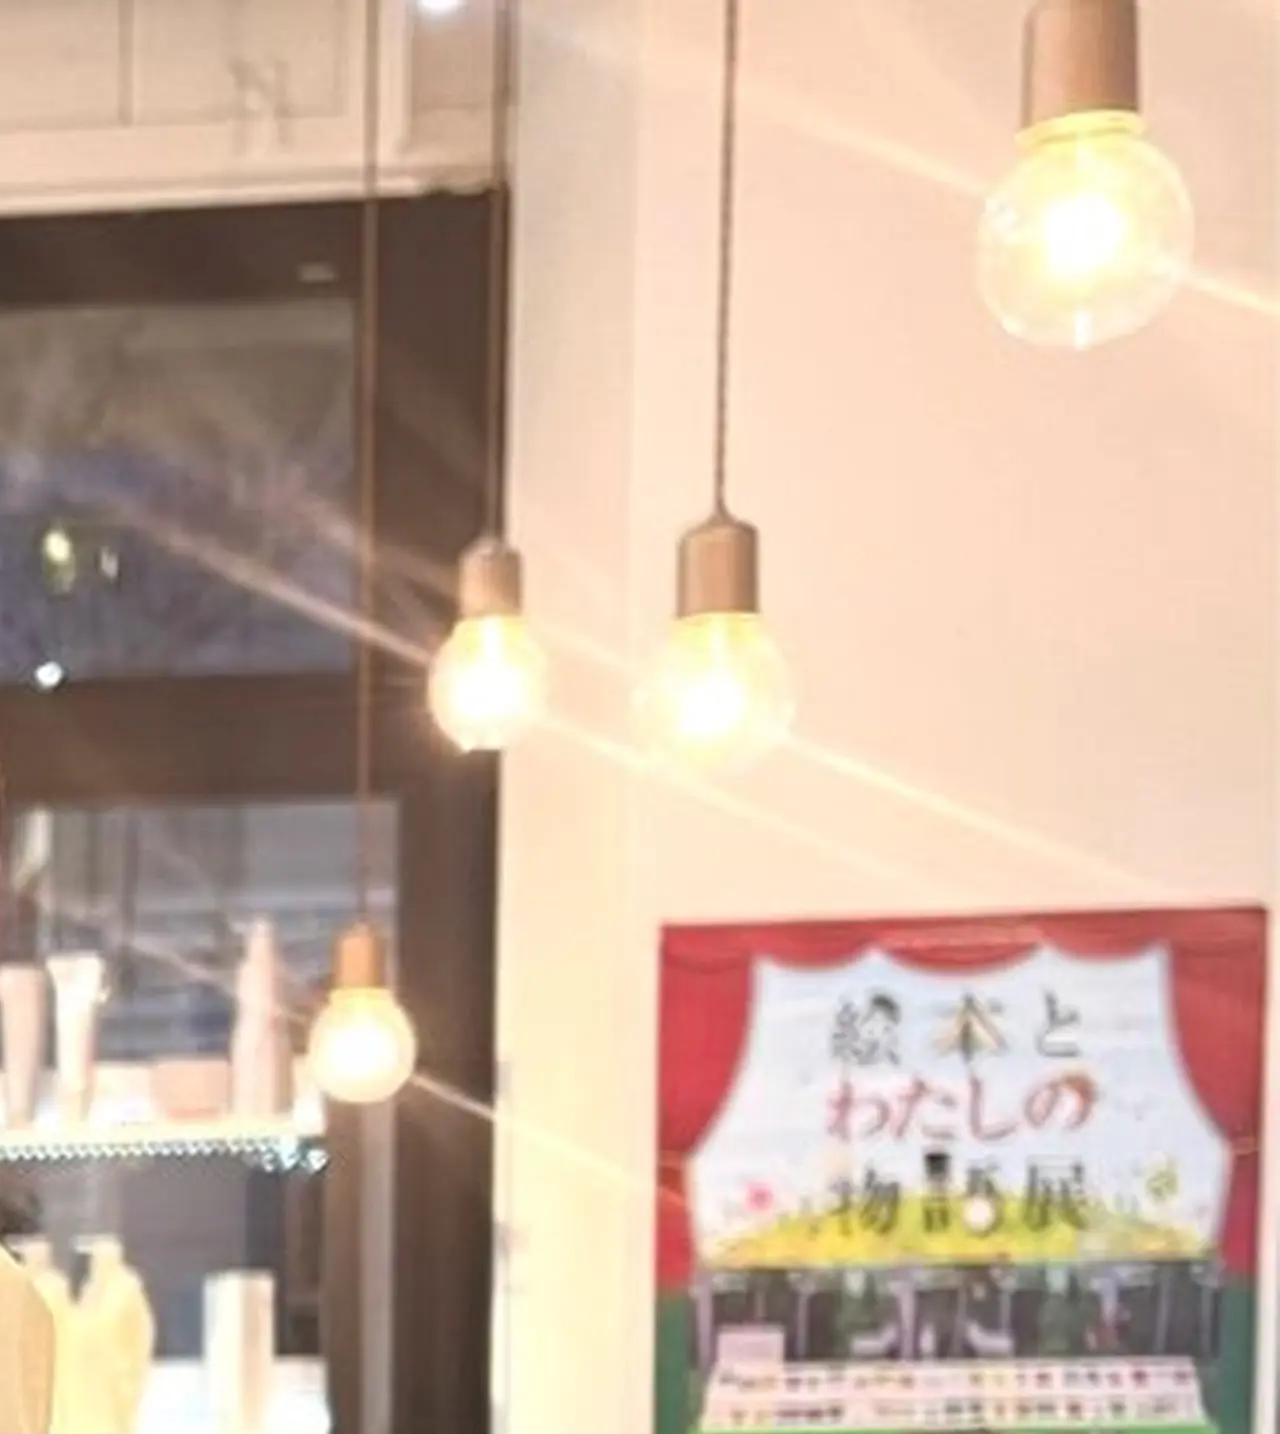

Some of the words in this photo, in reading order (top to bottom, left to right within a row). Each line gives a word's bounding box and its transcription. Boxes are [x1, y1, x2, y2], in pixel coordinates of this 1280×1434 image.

[830, 988, 1082, 1066] 絵本と
[827, 1068, 1095, 1140] わたしの
